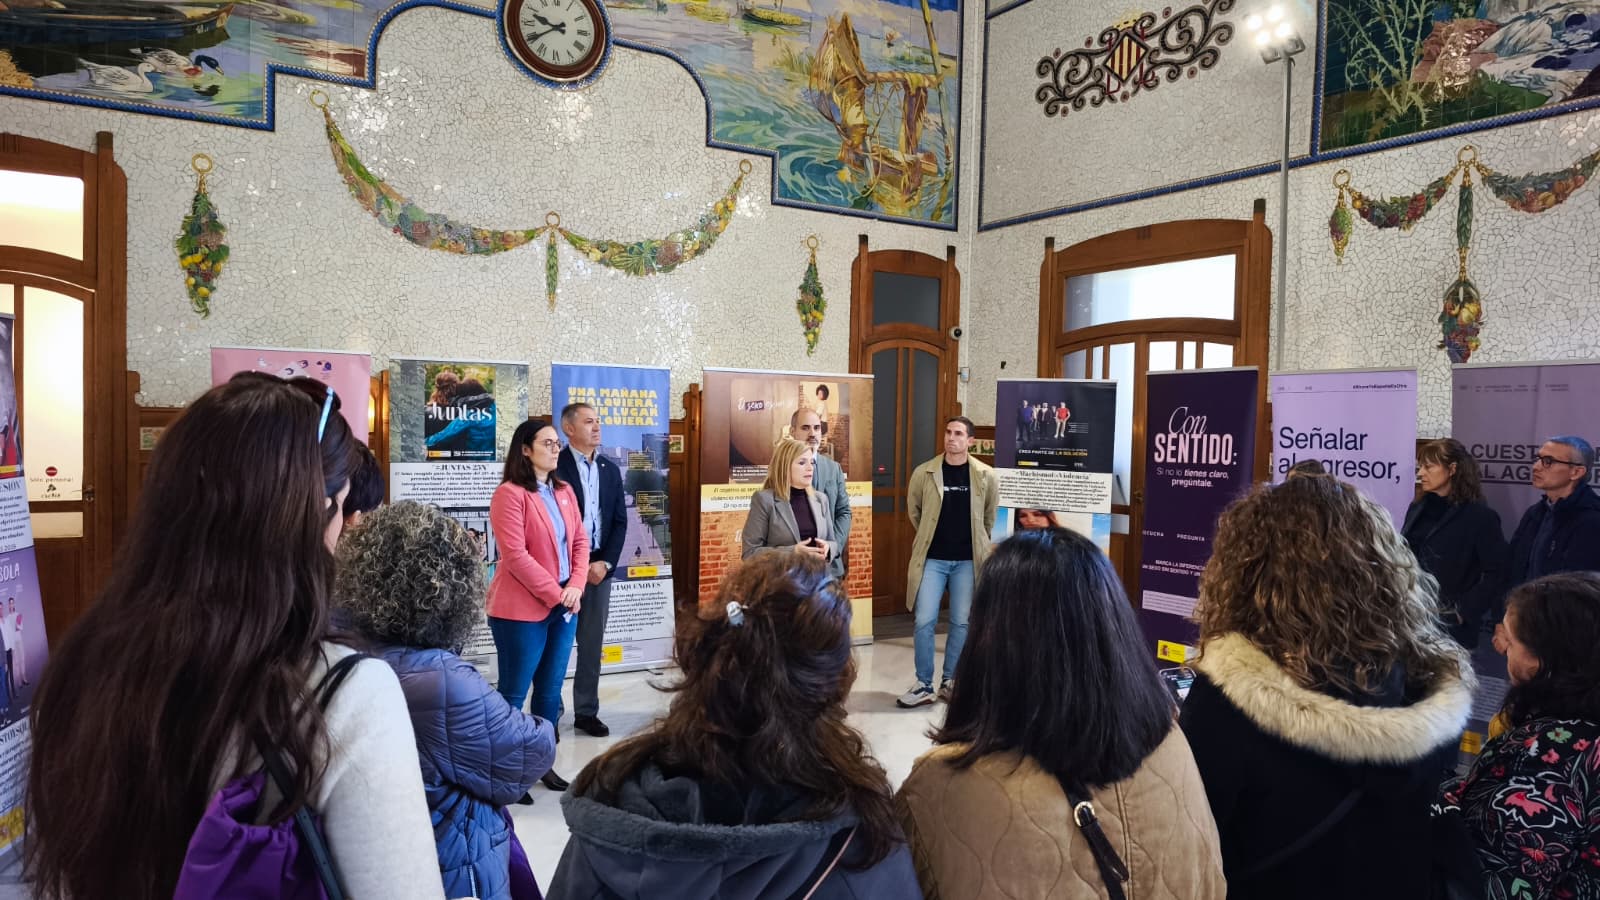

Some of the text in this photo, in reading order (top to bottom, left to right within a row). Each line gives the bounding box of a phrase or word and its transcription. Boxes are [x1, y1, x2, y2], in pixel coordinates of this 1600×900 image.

[568, 386, 658, 399] UNA MAÑANA
[428, 401, 493, 422] Juntas
[613, 406, 658, 417] LUGAR
[1168, 406, 1208, 435] Con
[1279, 426, 1368, 451] Señalar
[1154, 432, 1238, 466] SENTIDO:
[1471, 443, 1539, 460] CUEST
[1156, 467, 1230, 481] Si no lo tienes claro,
[1322, 458, 1401, 485] gresor,
[1171, 478, 1215, 488] pregúntale.
[1177, 533, 1205, 541] PREGUNTA
